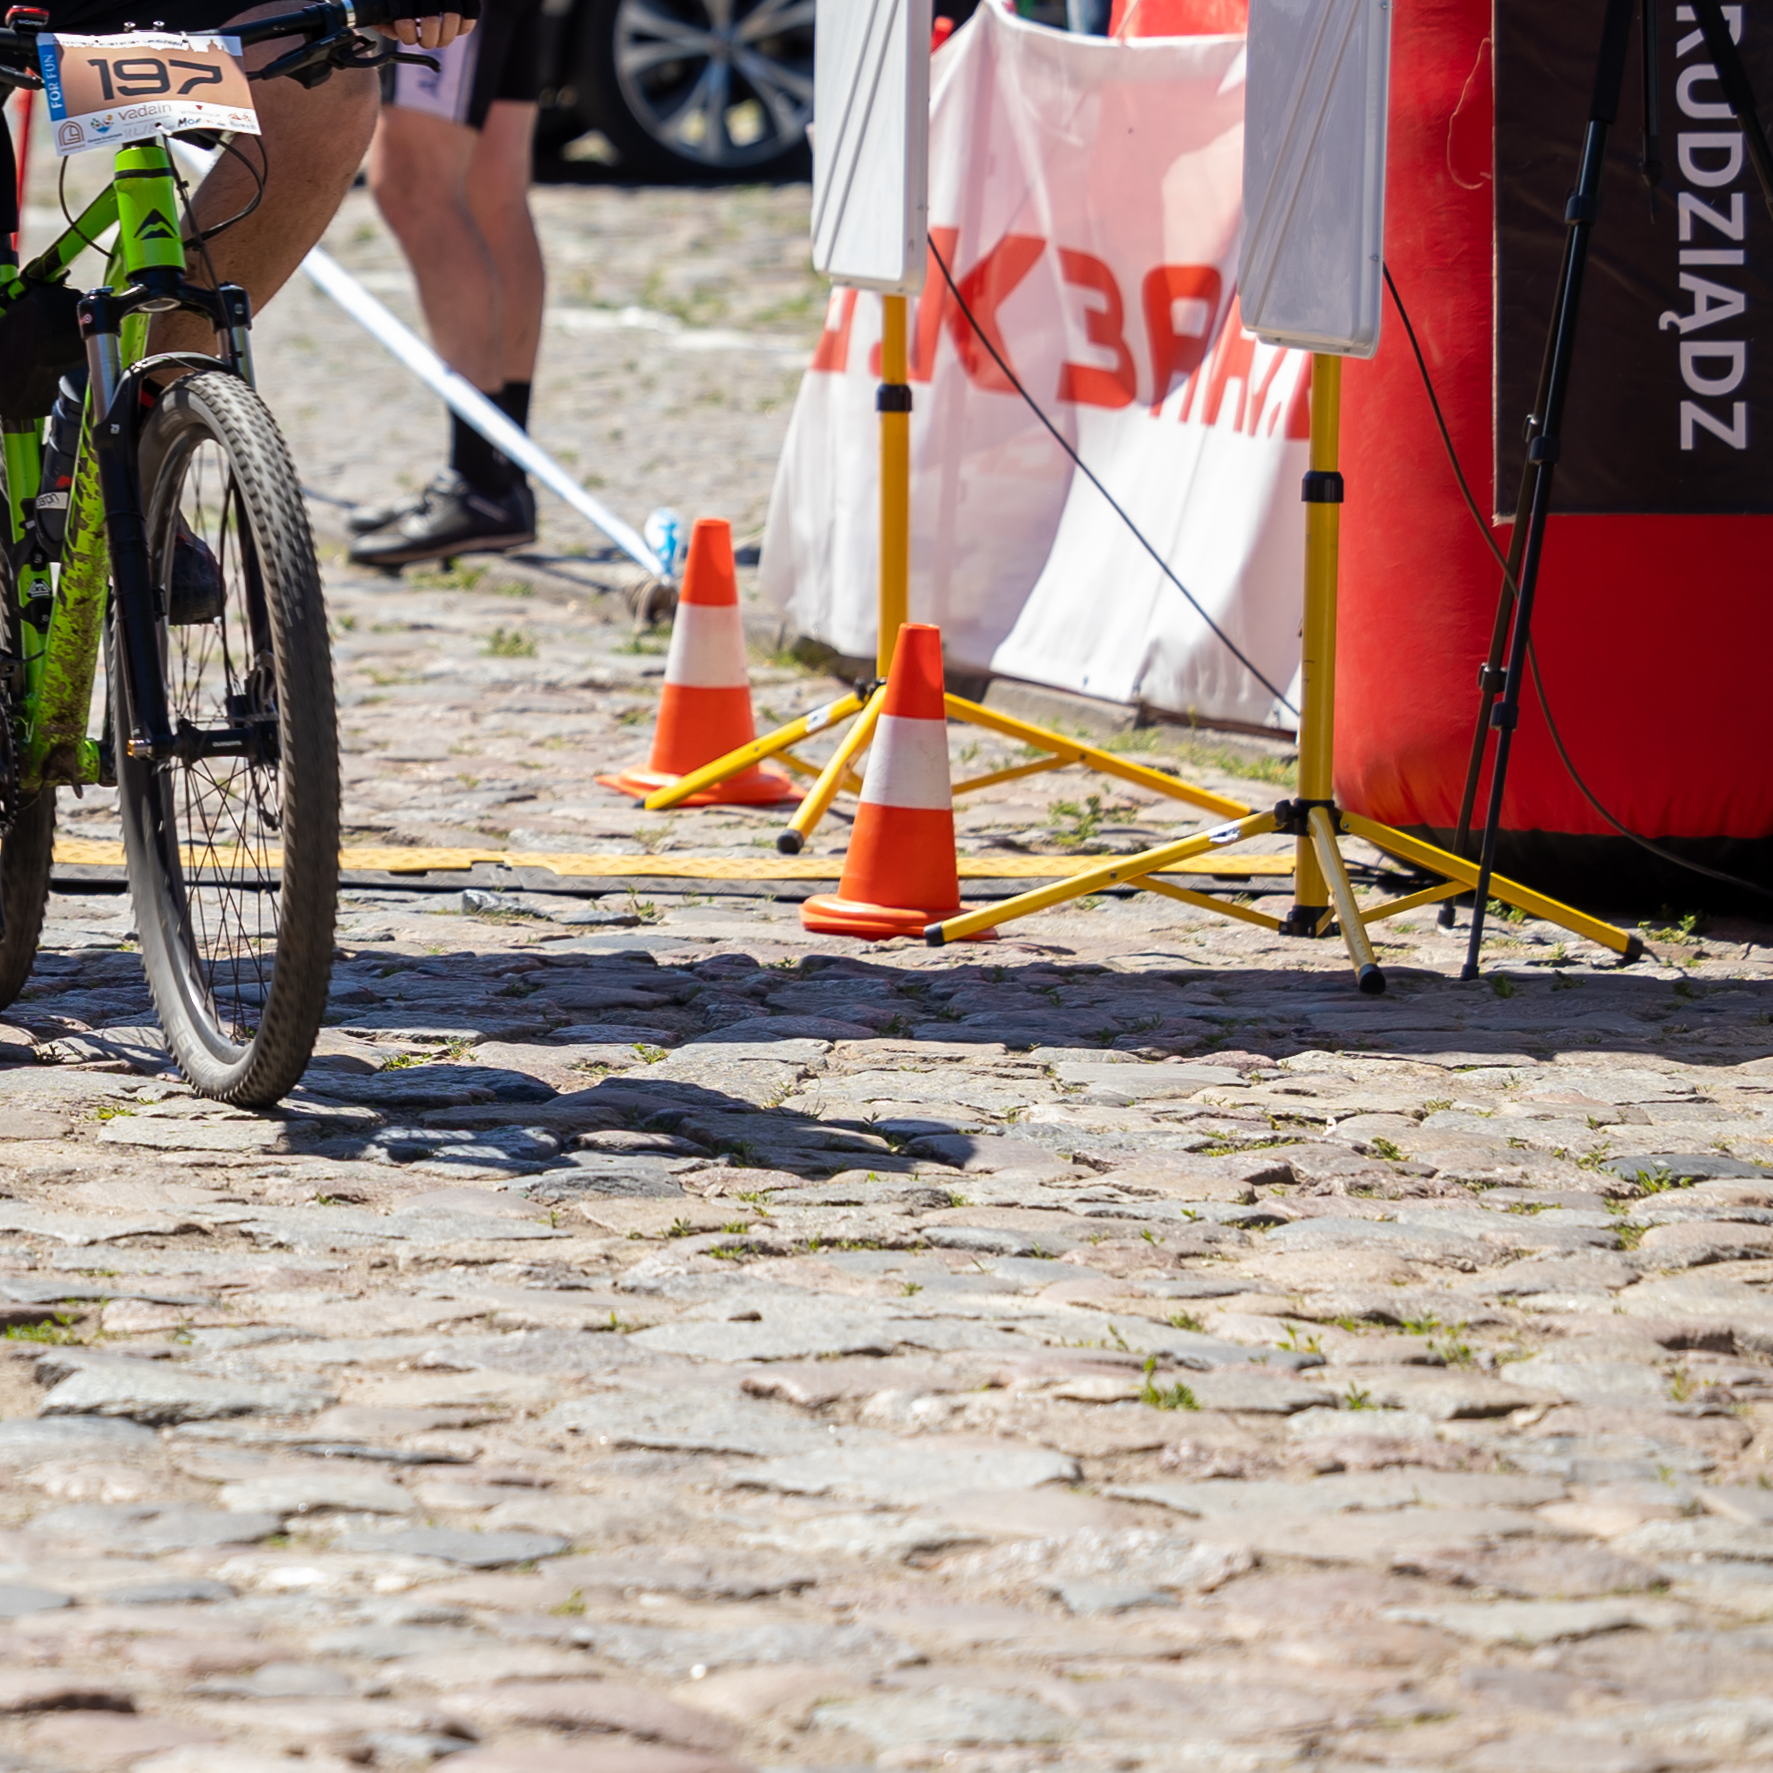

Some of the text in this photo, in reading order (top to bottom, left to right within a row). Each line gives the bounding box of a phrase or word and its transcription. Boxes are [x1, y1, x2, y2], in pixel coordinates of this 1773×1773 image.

[42, 54, 63, 109] FOR FUN
[87, 58, 223, 101] 197
